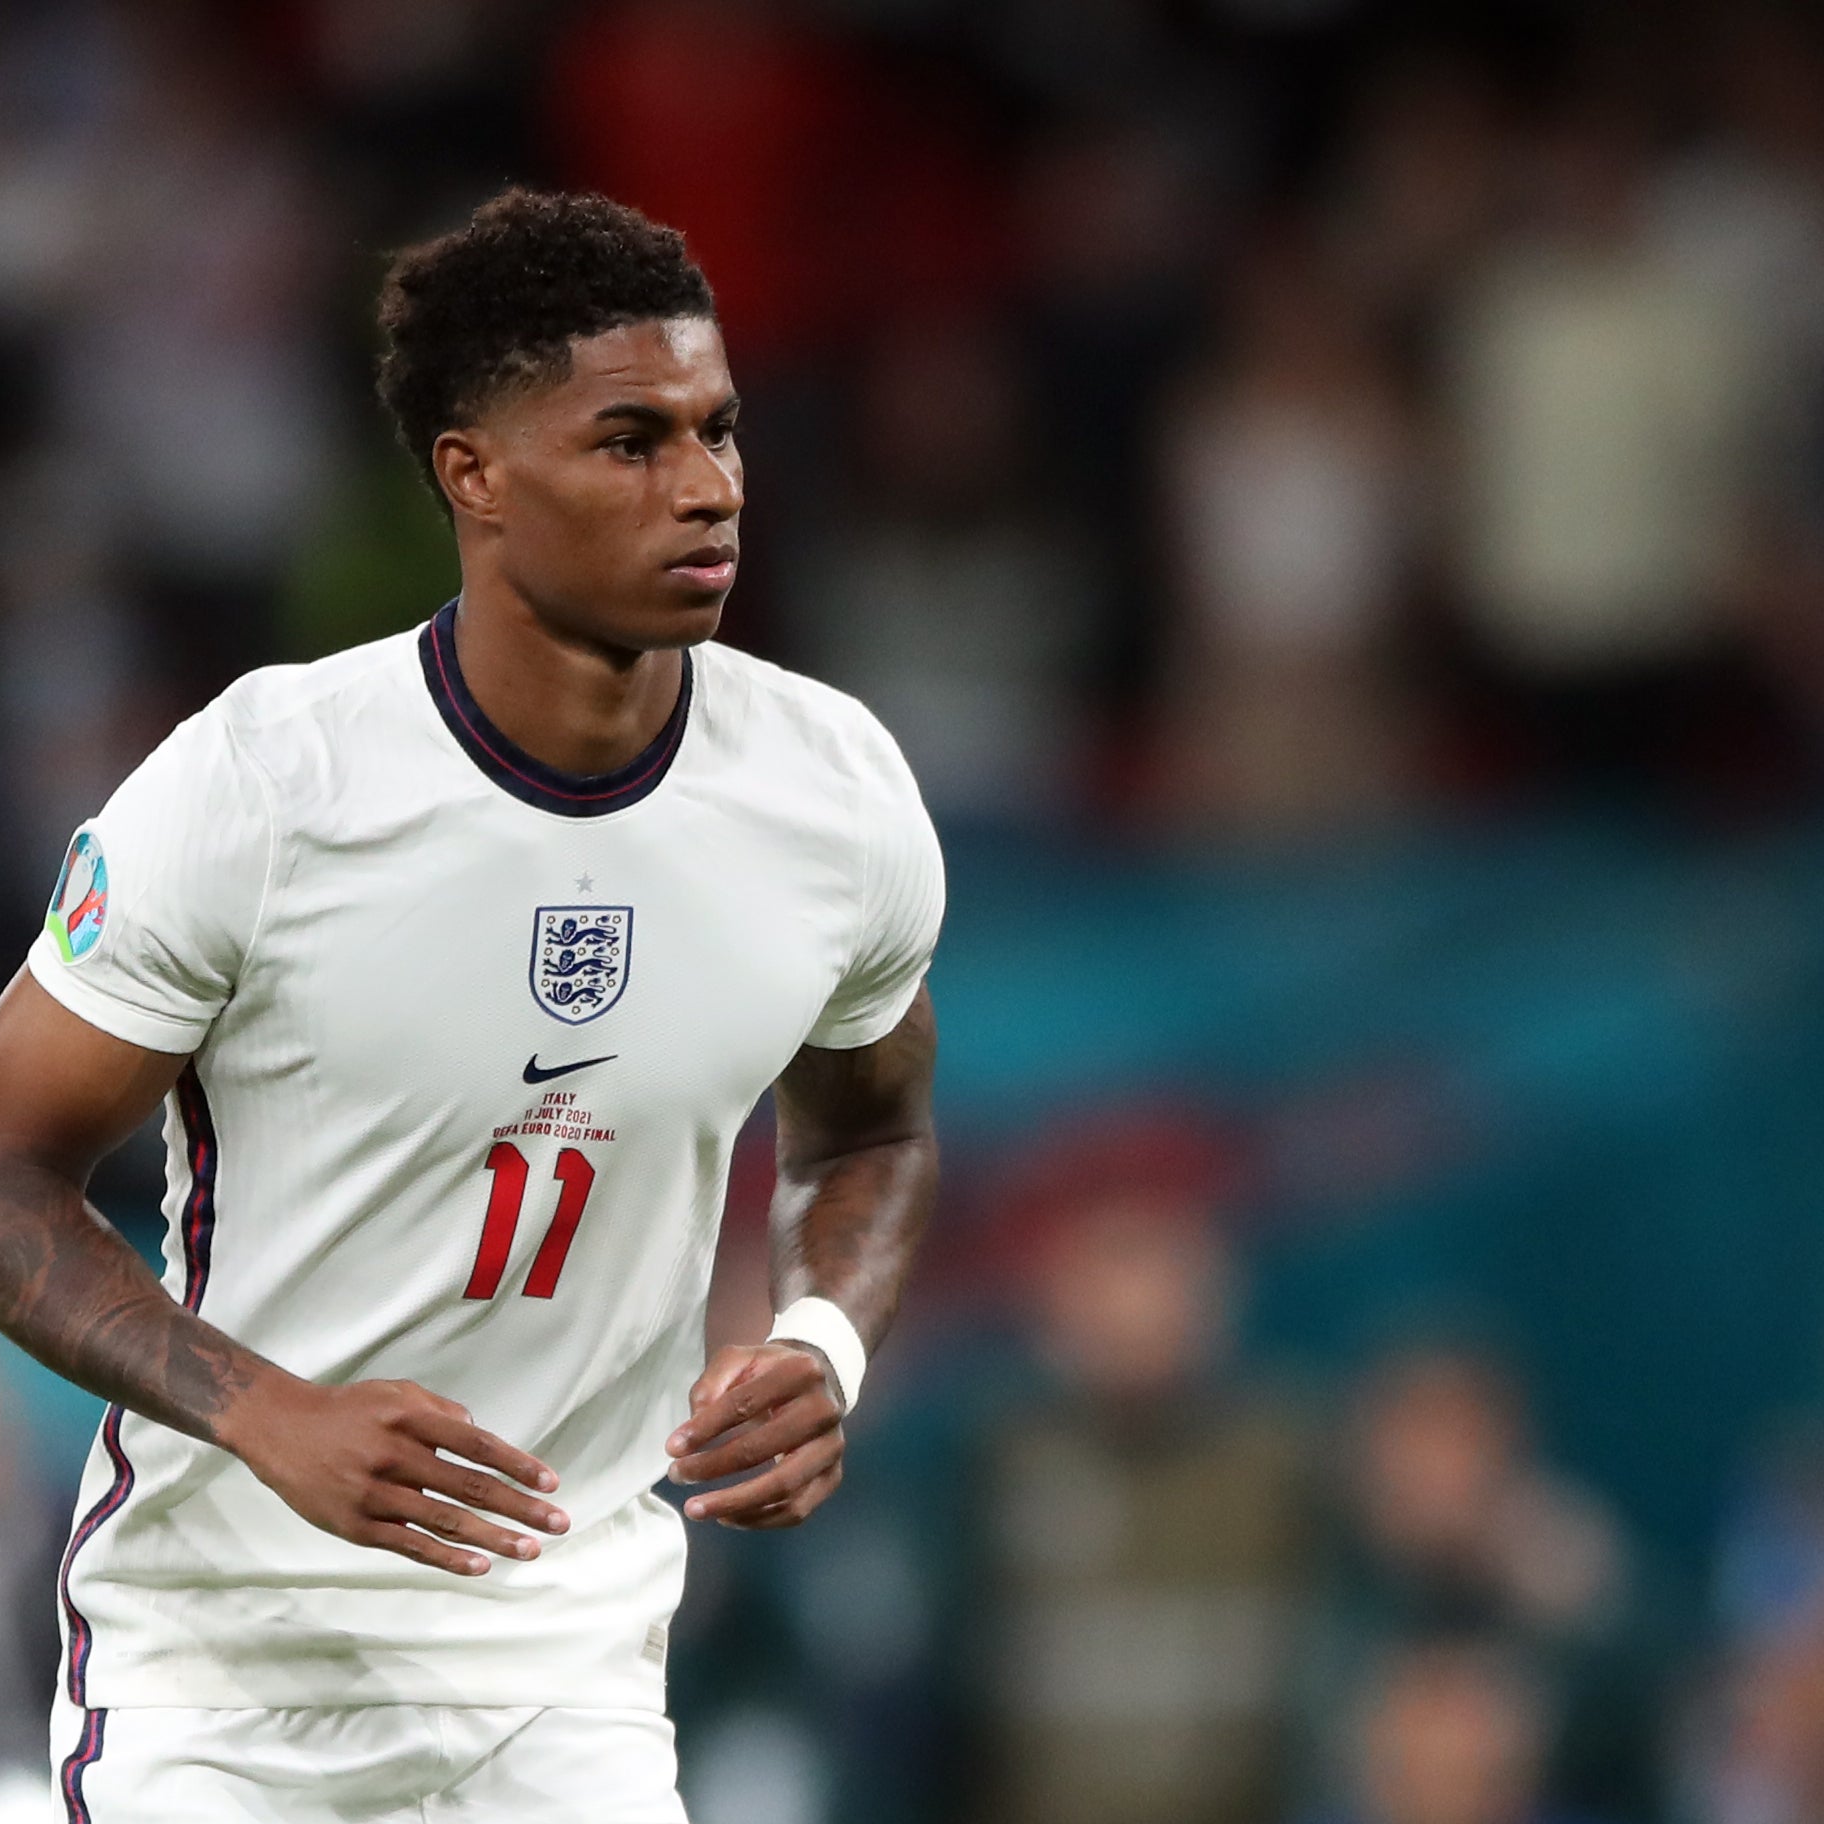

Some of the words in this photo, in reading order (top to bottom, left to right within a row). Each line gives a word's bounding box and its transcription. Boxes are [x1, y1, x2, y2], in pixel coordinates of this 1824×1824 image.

[542, 1092, 577, 1105] ITALY
[524, 1109, 533, 1120] 11
[534, 1107, 564, 1120] JULY
[566, 1109, 592, 1124] 2021
[493, 1124, 518, 1138] UEFA
[521, 1122, 552, 1135] EURO
[554, 1124, 581, 1140] 2020
[583, 1128, 616, 1141] FINAL
[462, 1141, 596, 1300] 11
